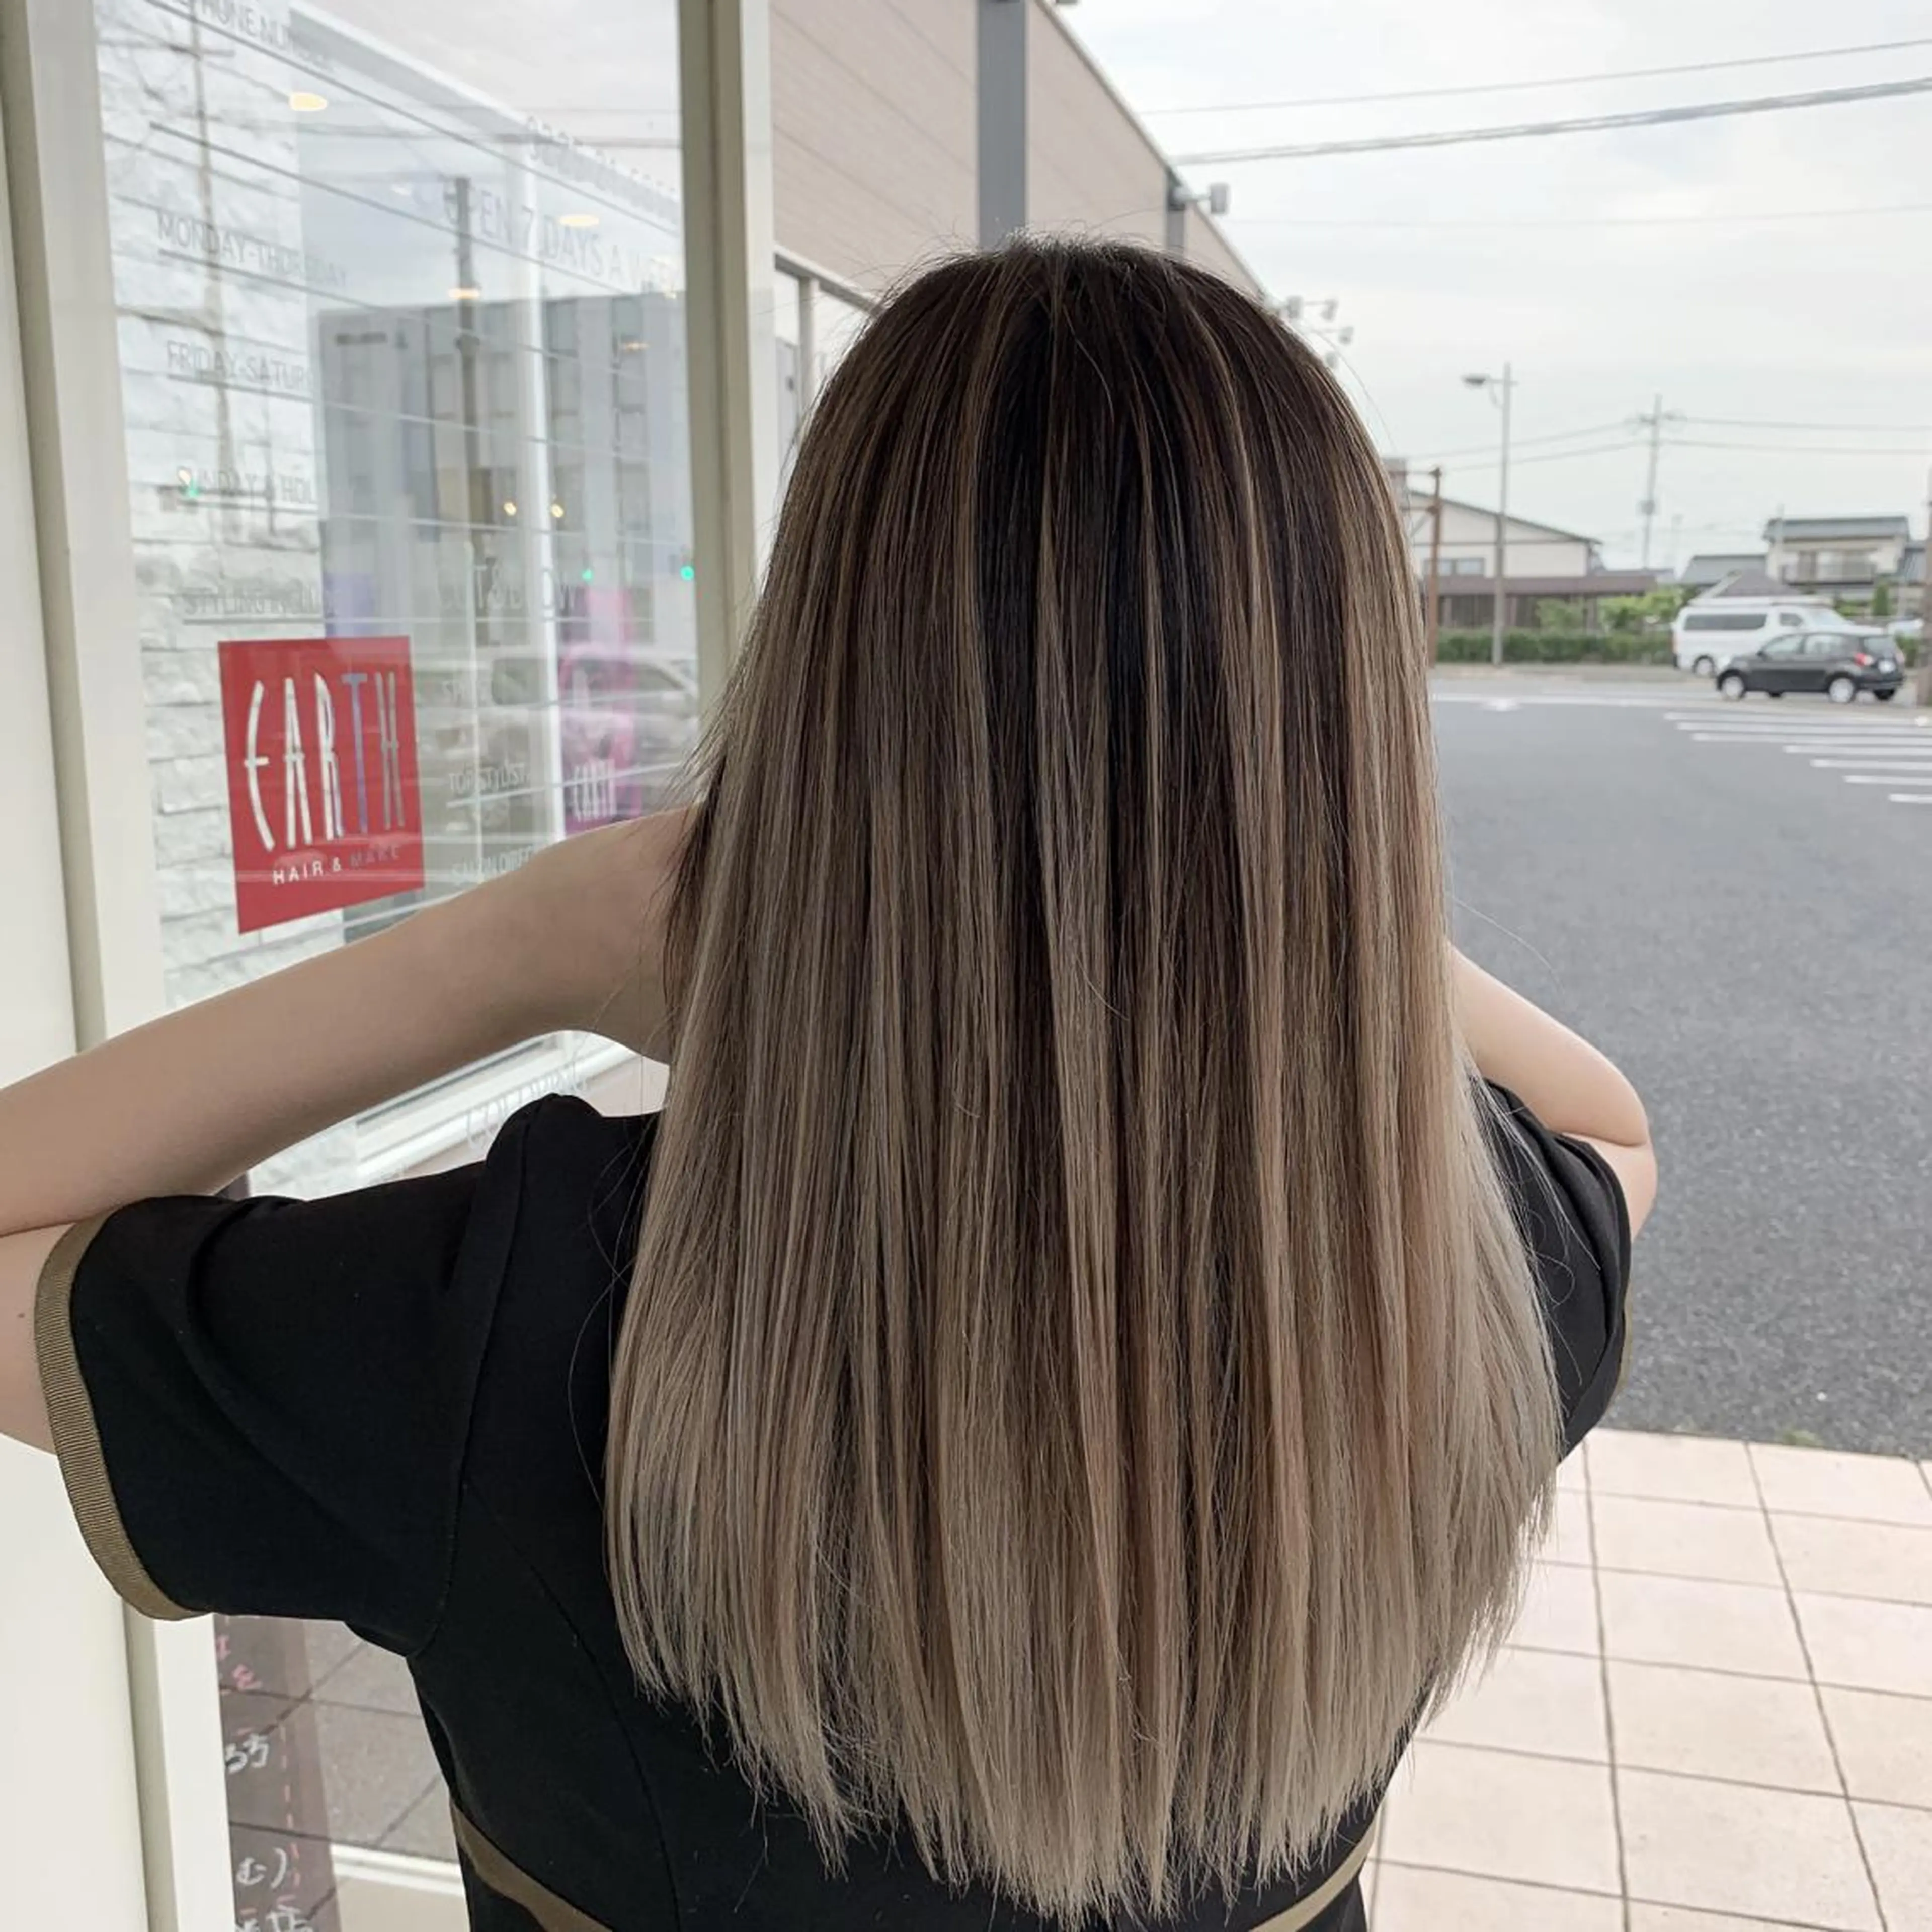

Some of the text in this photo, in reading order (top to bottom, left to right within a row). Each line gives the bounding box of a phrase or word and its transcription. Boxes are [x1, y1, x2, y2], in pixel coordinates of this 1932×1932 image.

[244, 671, 406, 852] EARTH
[272, 860, 324, 886] HAIR
[332, 856, 341, 872] &
